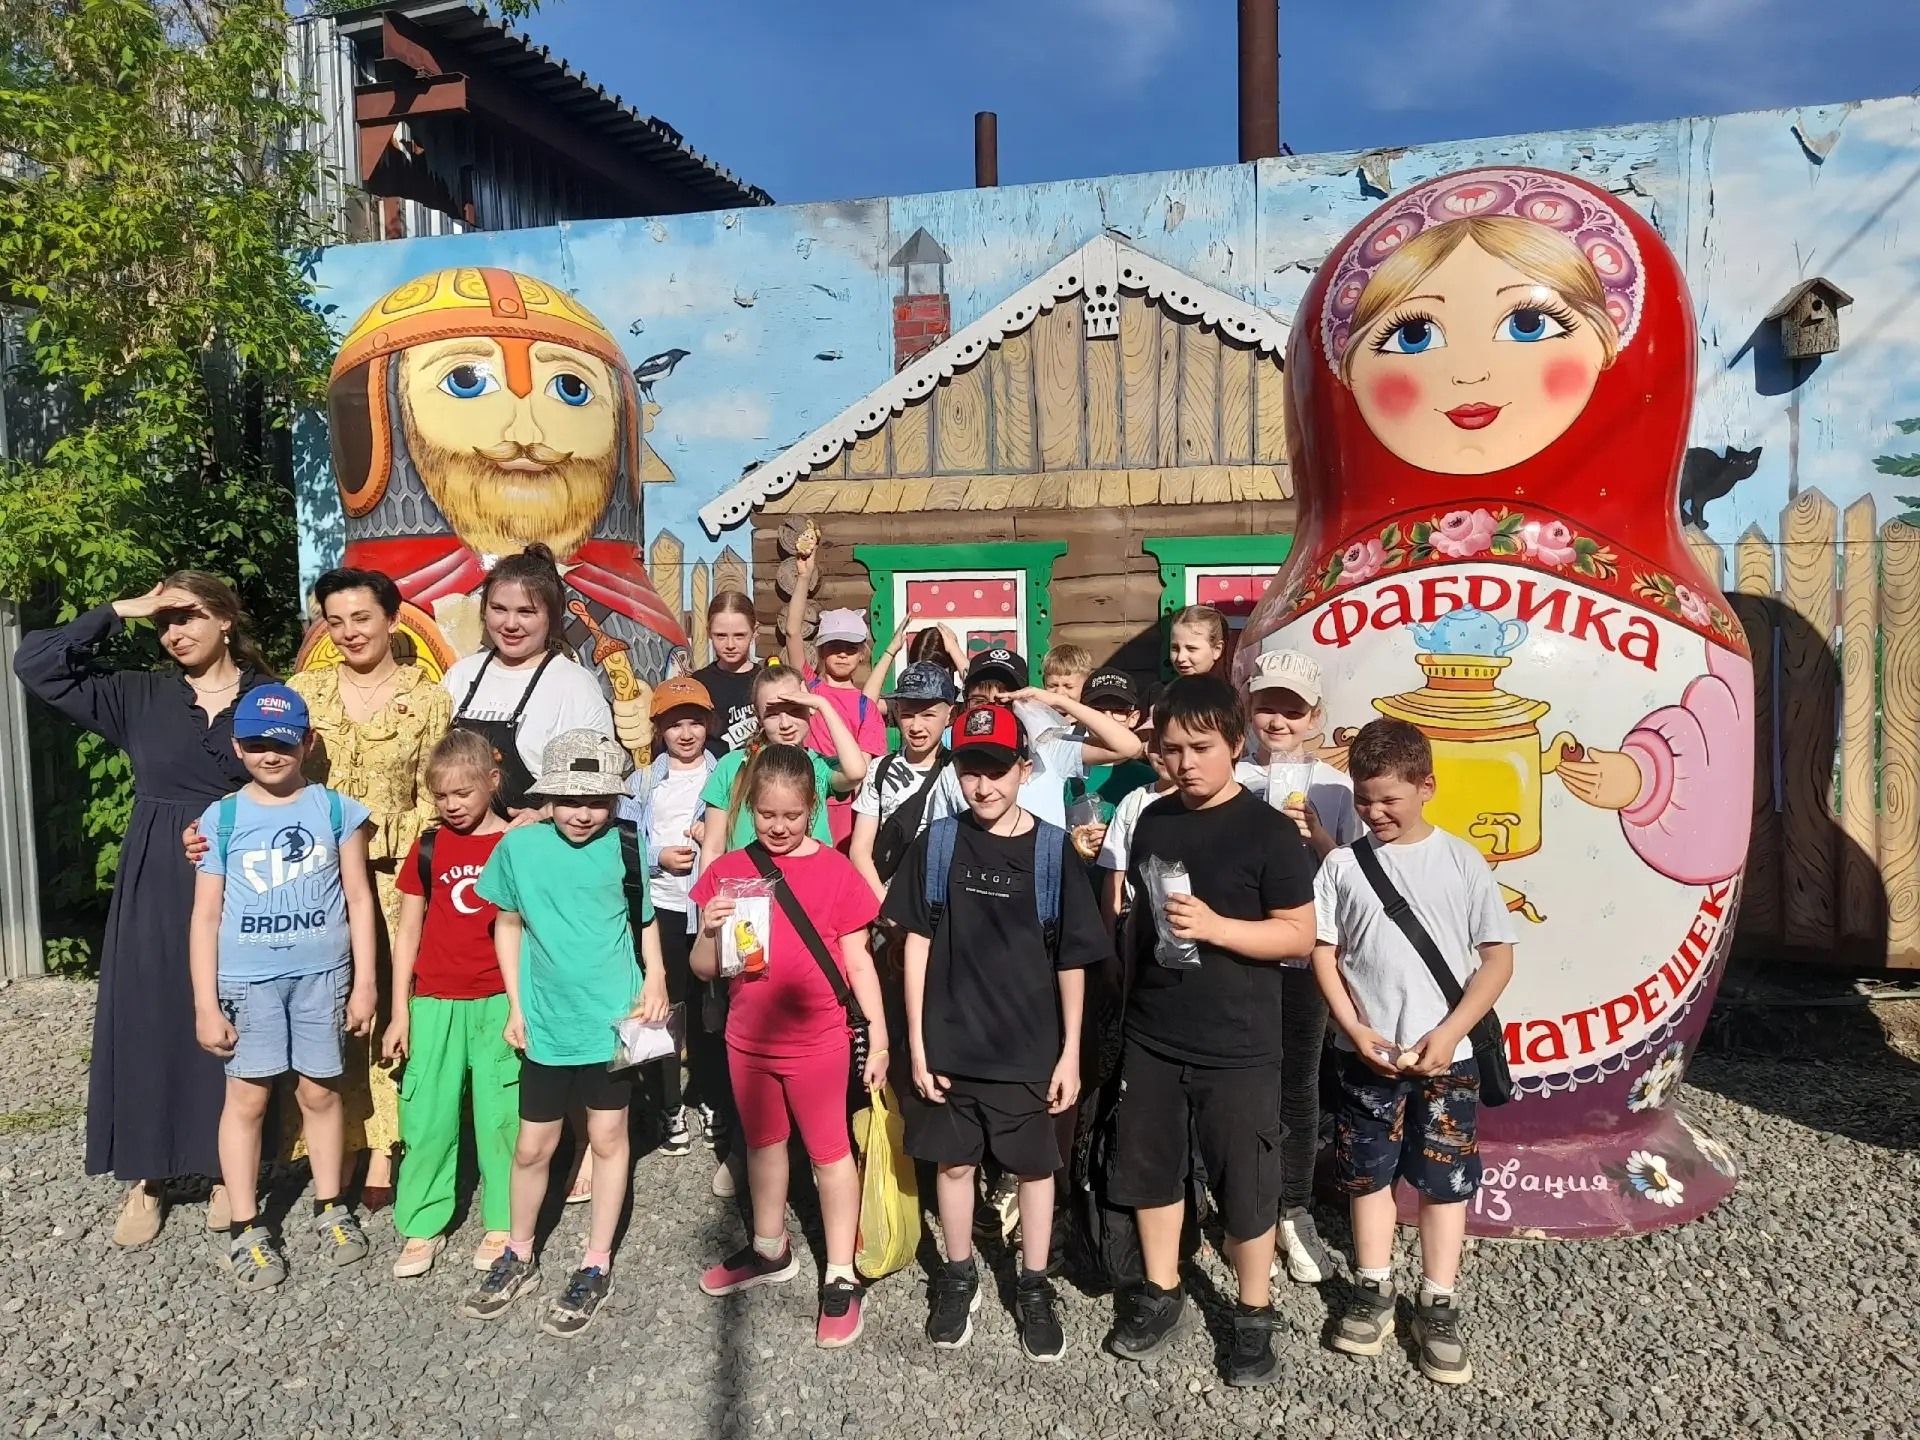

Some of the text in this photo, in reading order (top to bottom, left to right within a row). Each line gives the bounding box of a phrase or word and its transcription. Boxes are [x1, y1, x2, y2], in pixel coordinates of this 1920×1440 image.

[256, 697, 291, 711] DENIM
[728, 703, 756, 724] Луч
[439, 864, 486, 885] TÜRK
[240, 909, 327, 934] BRDNG
[1480, 1158, 1614, 1197] ования
[1473, 1187, 1513, 1222] 13
